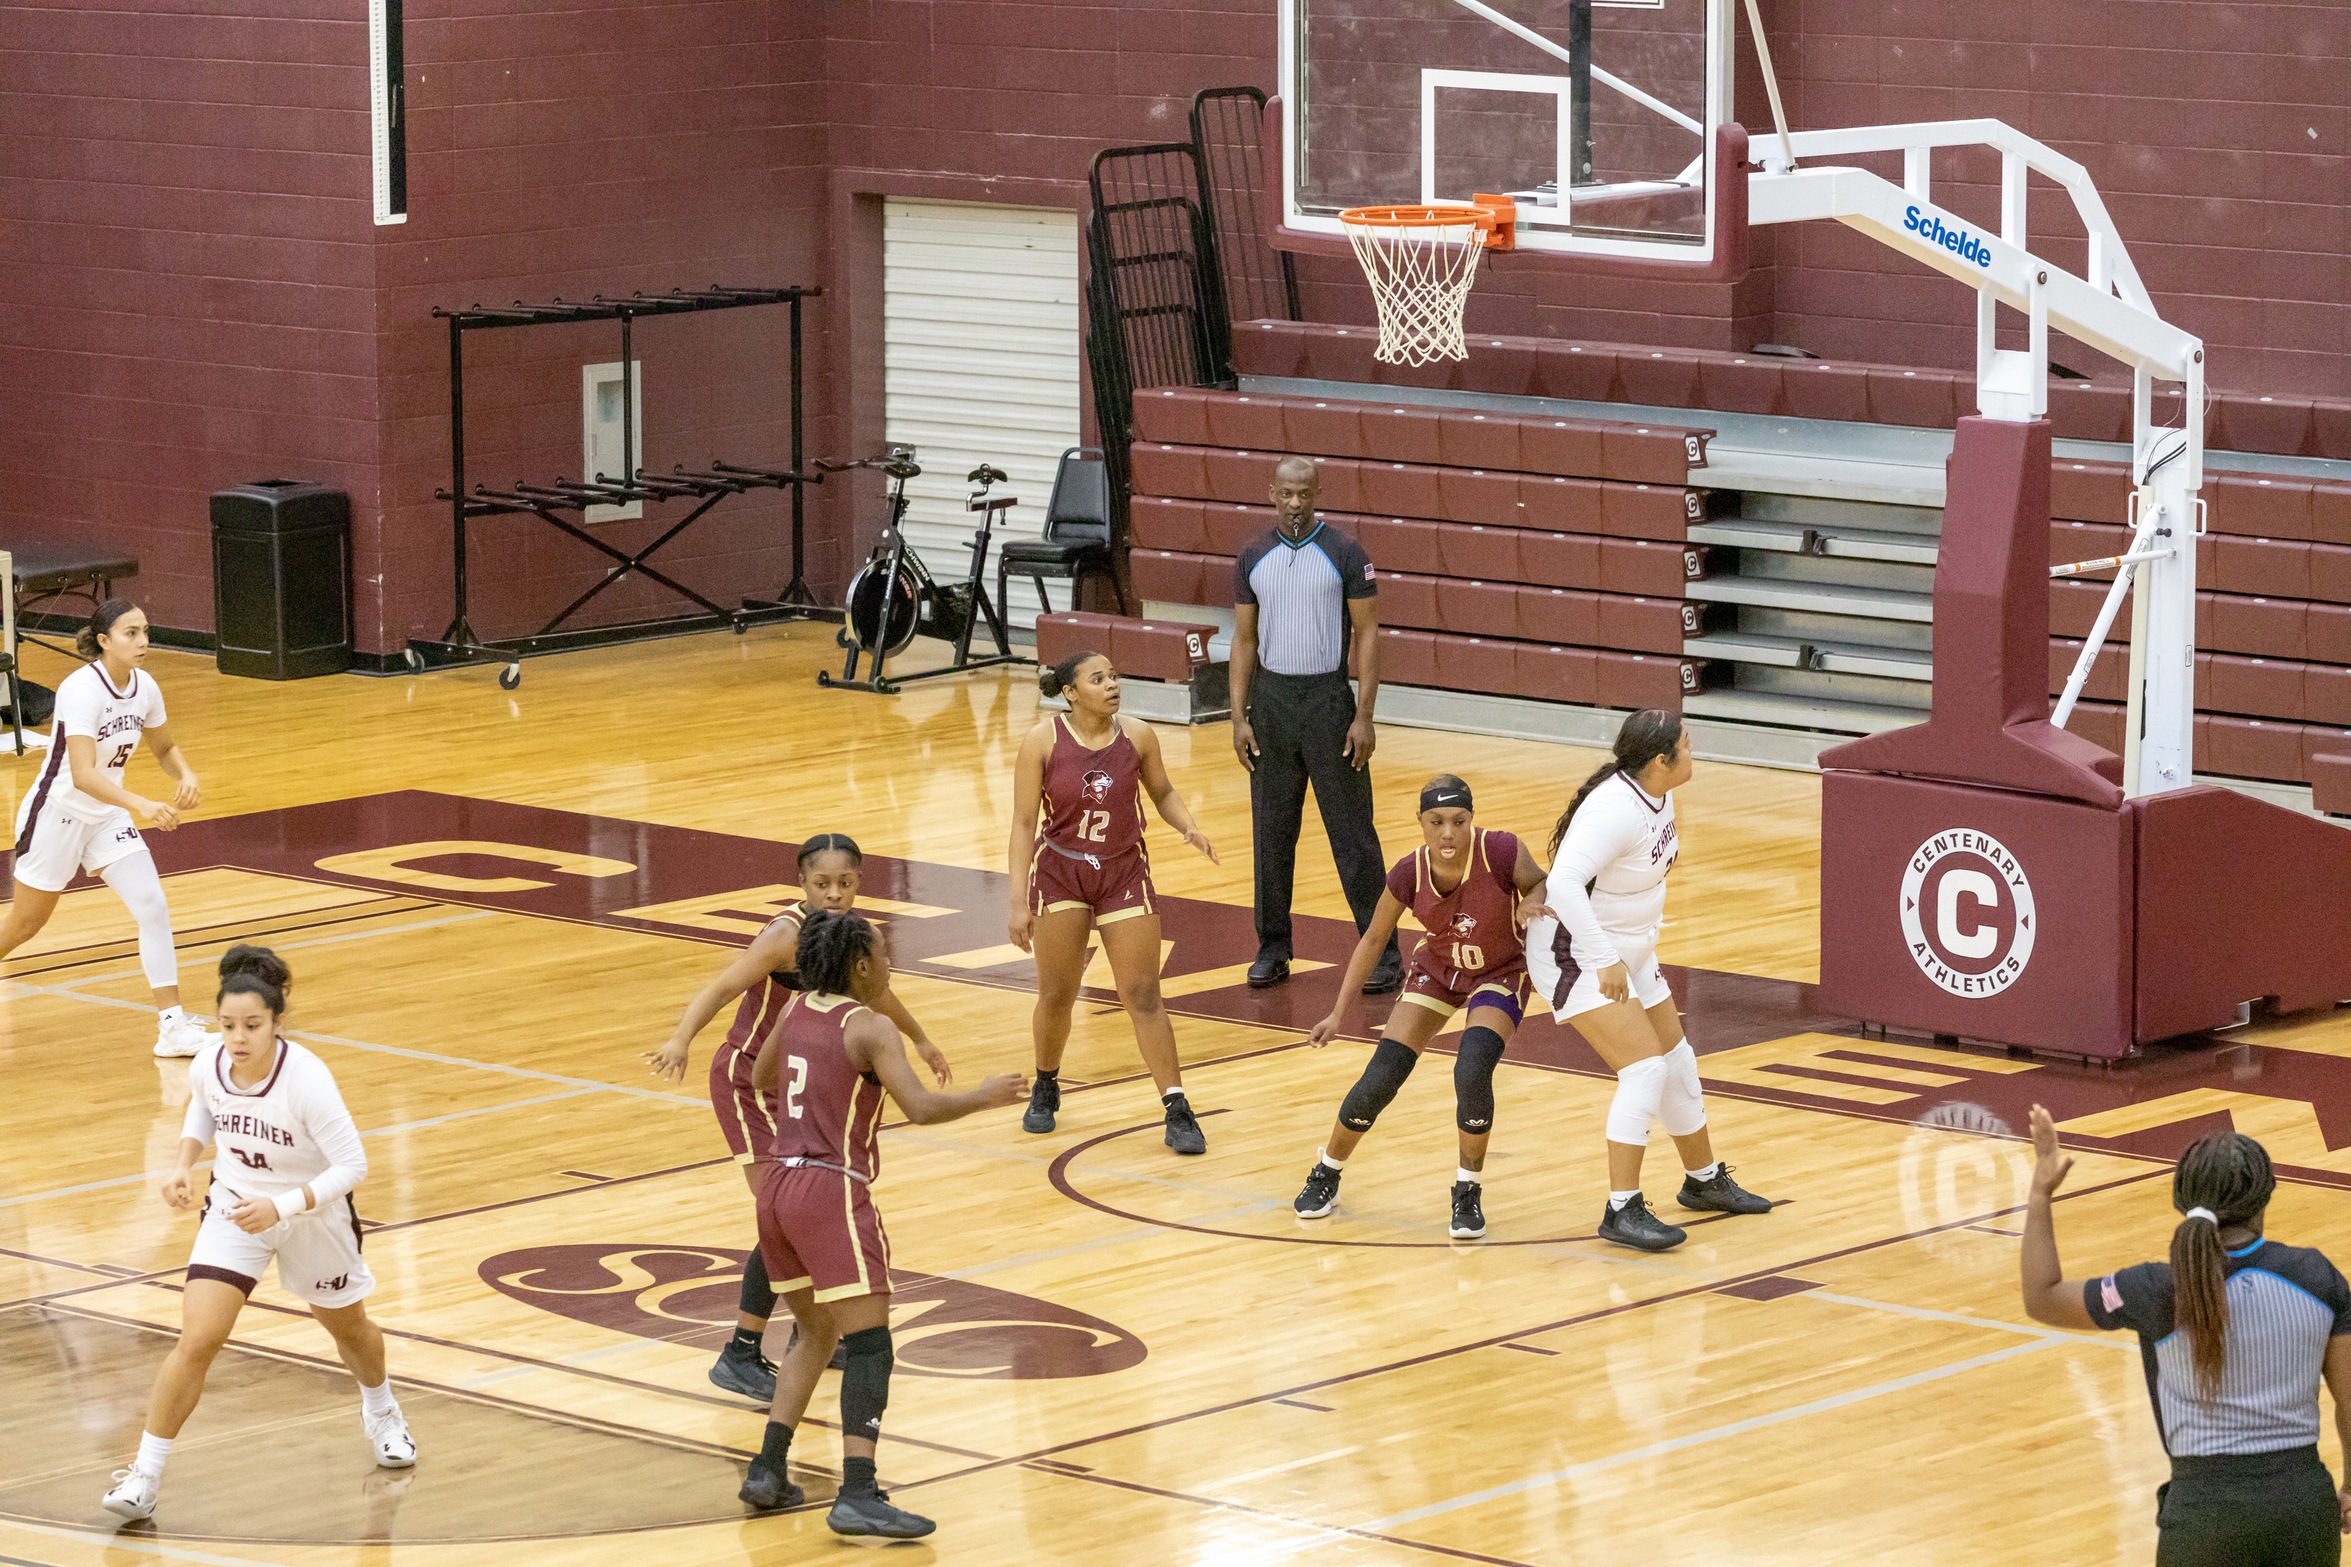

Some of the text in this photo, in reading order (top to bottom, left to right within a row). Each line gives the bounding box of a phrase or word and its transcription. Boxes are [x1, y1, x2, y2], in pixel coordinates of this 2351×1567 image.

[1903, 205, 1991, 268] Schelde
[107, 743, 134, 768] 15
[1077, 809, 1111, 843] 12
[1913, 833, 2025, 888] CENTENARY
[1937, 868, 1998, 959] C
[1450, 941, 1485, 970] 10
[1913, 942, 2020, 992] ATHLETICS
[787, 1054, 808, 1119] 2
